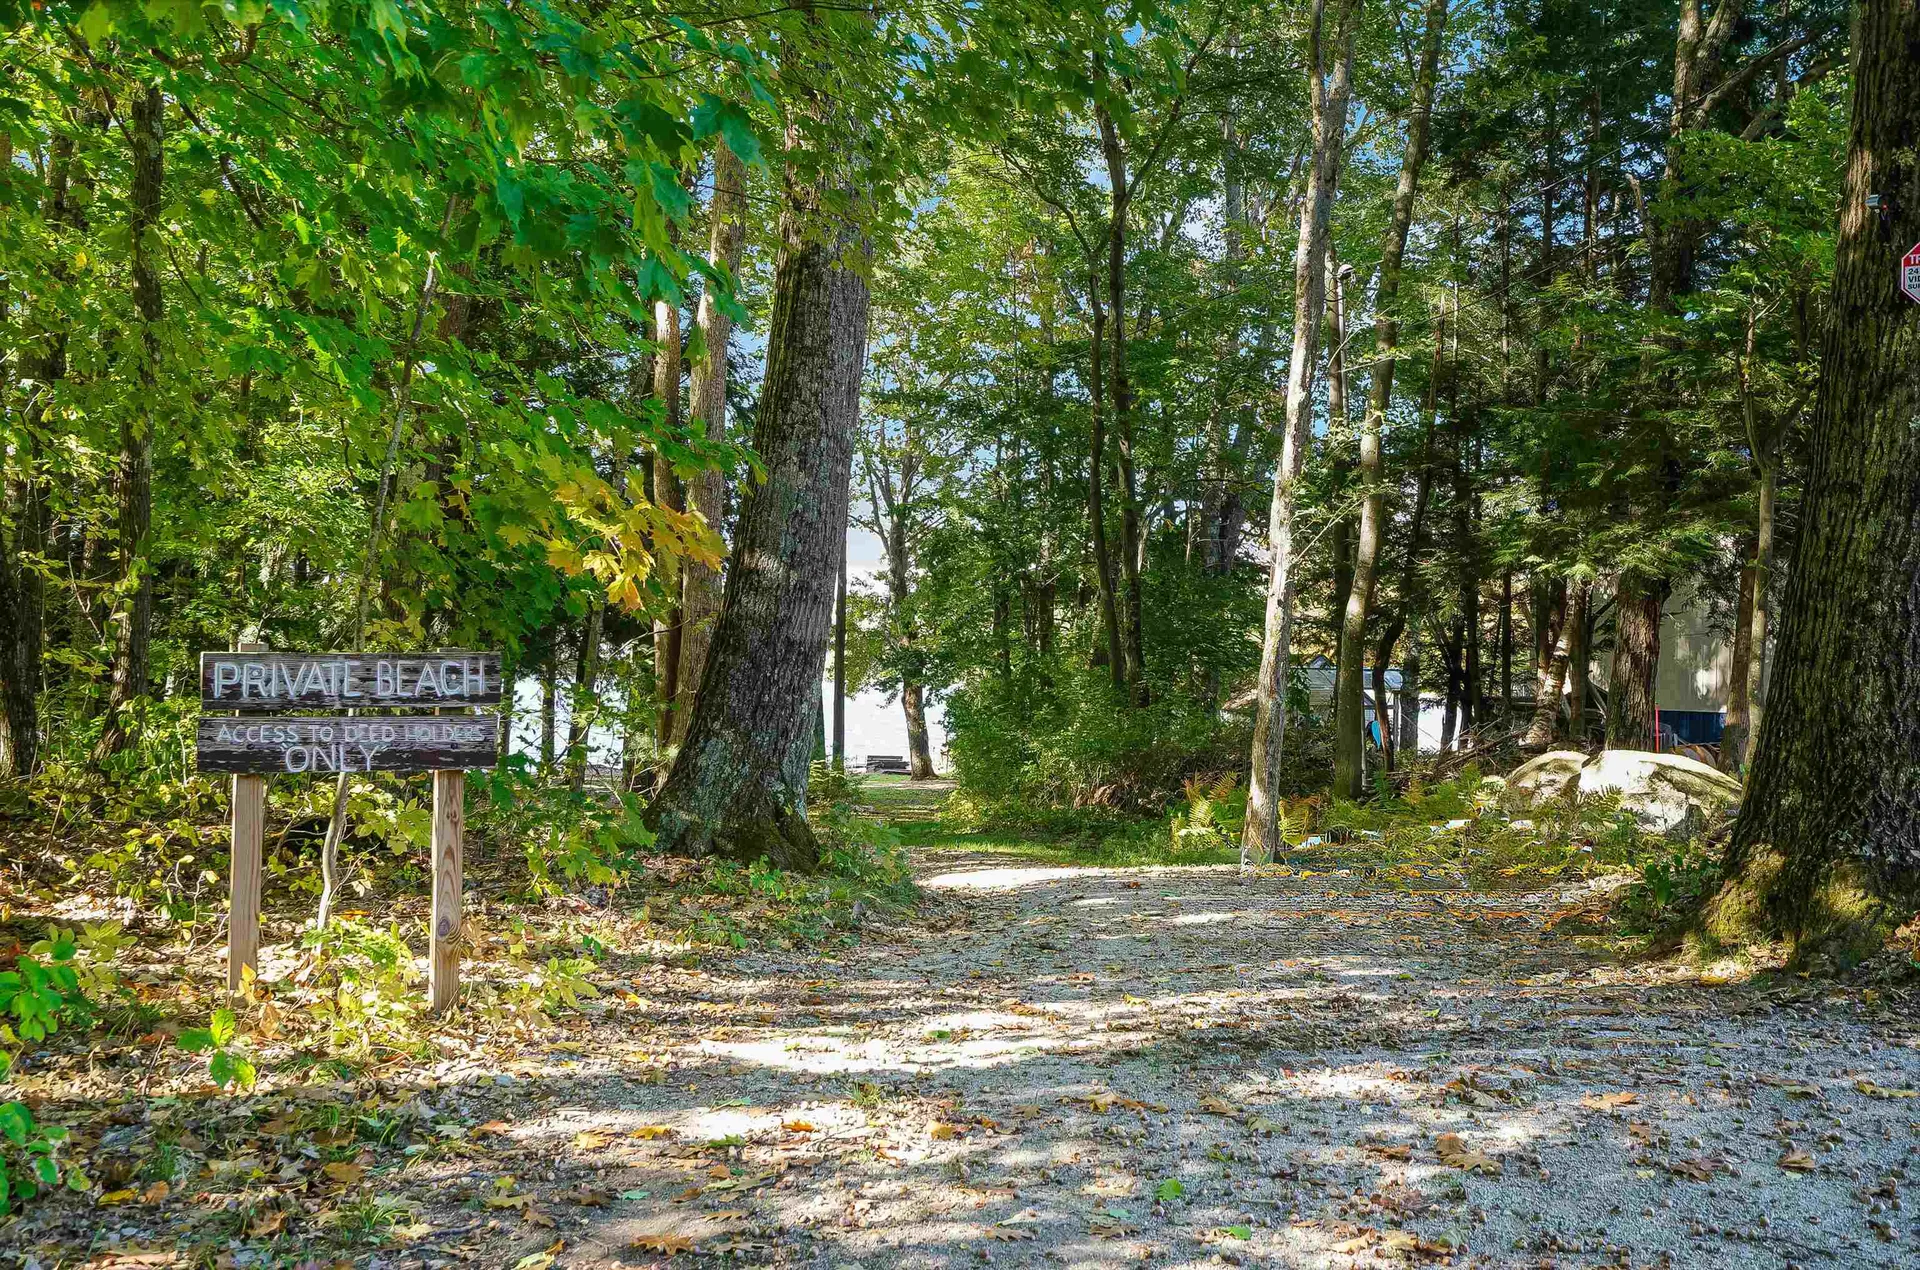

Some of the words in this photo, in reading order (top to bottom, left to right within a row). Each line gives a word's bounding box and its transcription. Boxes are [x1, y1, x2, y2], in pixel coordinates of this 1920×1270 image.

[212, 660, 362, 699] PRIVATE
[376, 659, 486, 698] BEACH
[216, 724, 299, 743] ACCESS
[308, 724, 334, 742] TO
[344, 723, 395, 743] DEED
